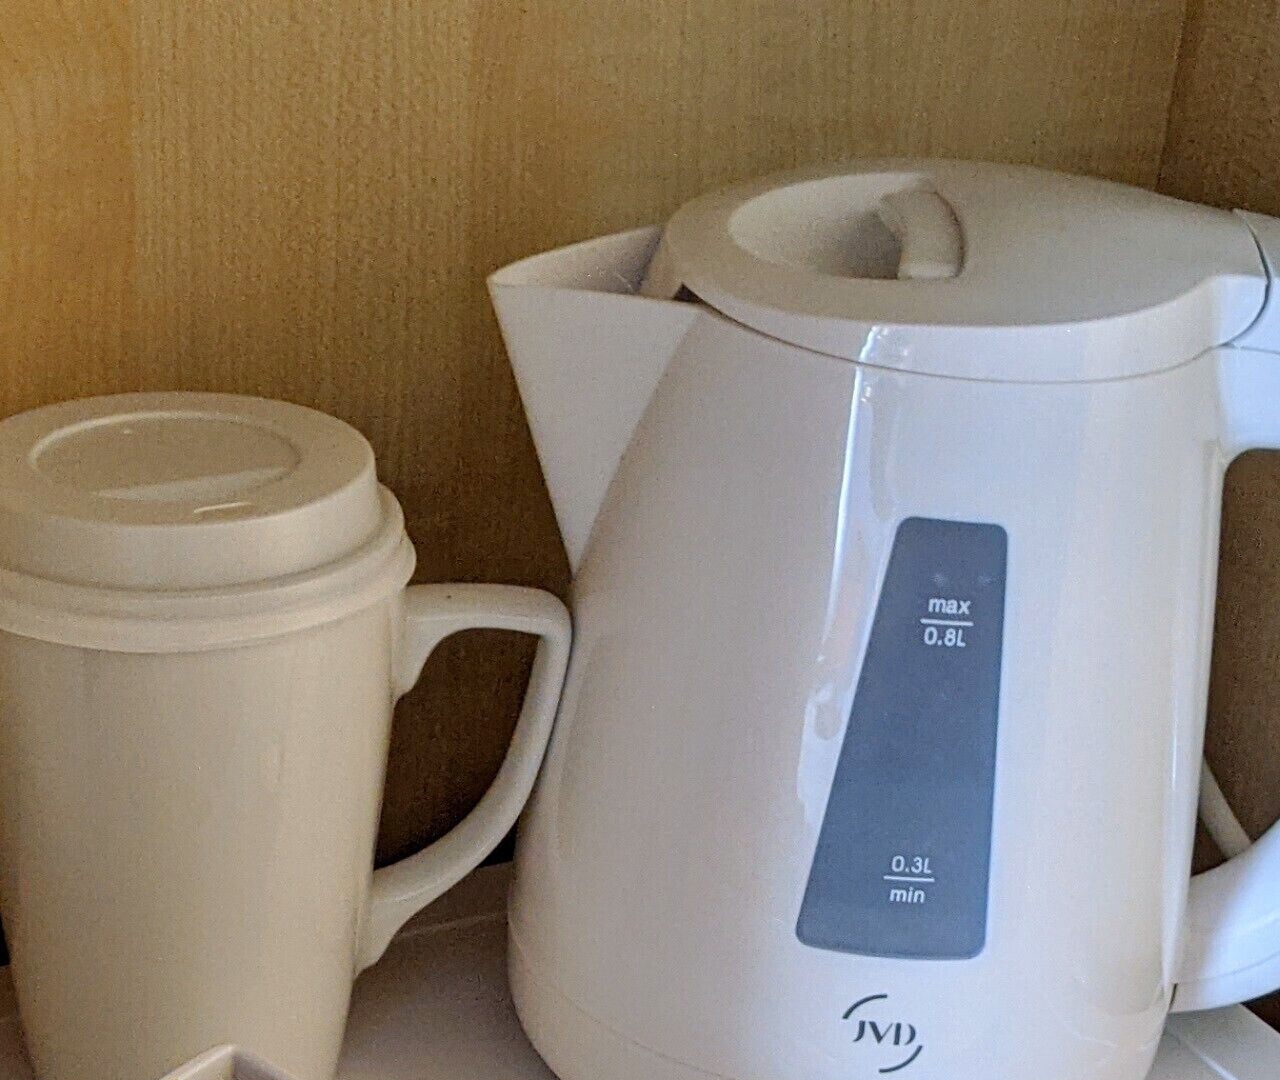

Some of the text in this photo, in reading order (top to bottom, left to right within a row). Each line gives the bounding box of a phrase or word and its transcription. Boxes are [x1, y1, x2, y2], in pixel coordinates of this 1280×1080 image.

[927, 595, 971, 616] max
[923, 626, 966, 649] 0.8L
[891, 855, 933, 875] 0.3L
[888, 886, 926, 905] min
[852, 1019, 917, 1046] JVD
